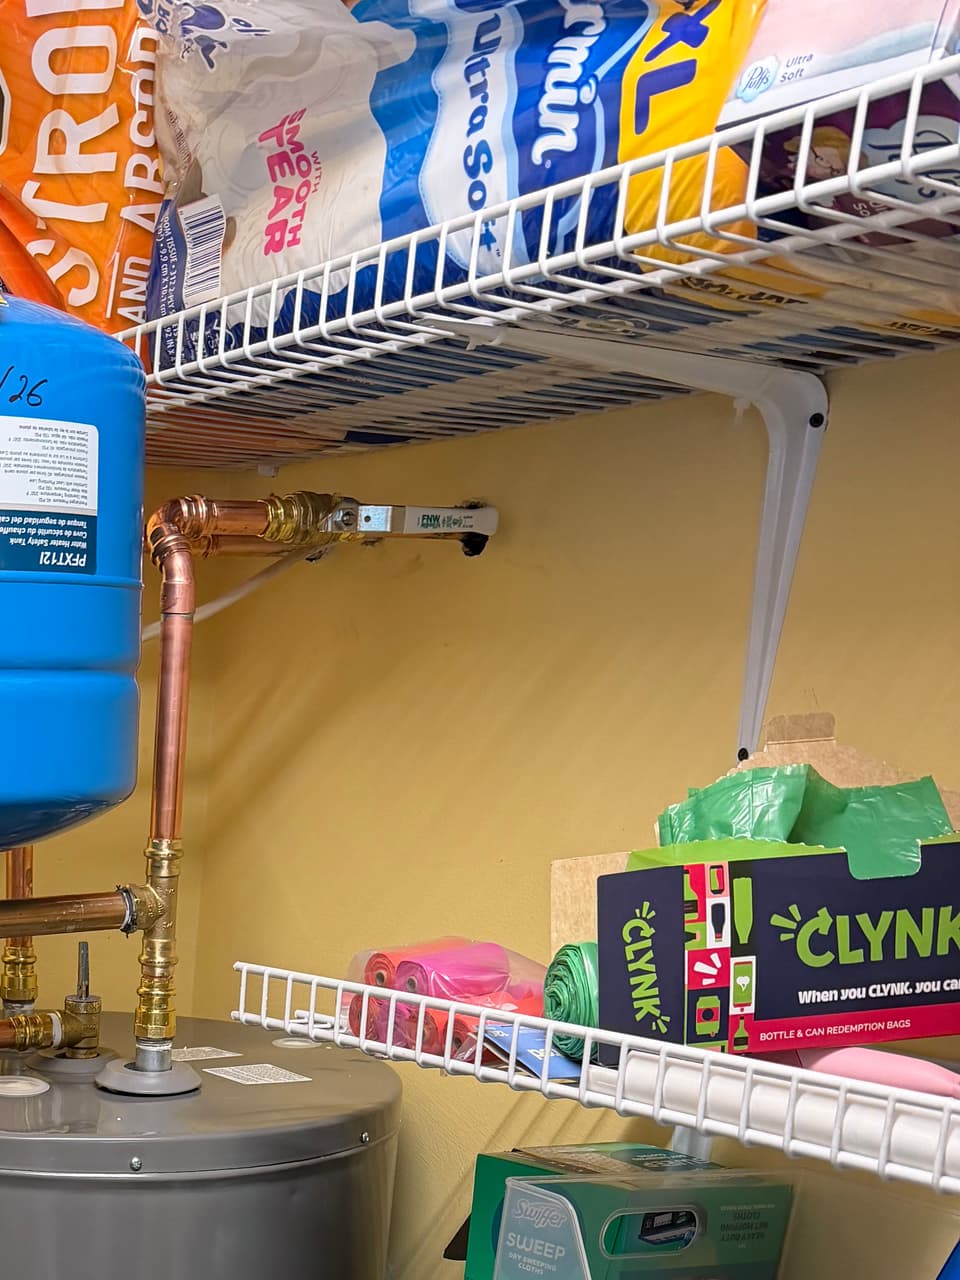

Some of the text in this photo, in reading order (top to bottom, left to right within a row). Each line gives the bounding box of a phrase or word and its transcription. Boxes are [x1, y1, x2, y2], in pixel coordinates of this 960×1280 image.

[785, 53, 814, 68] Ultra
[742, 66, 771, 92] Puffs
[779, 68, 804, 83] Soft
[463, 14, 501, 251] Ultra Sot
[21, 0, 124, 308] STRO
[284, 107, 312, 248] SMOOTH
[309, 150, 323, 194] WITH
[258, 115, 294, 257] TEAR
[166, 237, 178, 264] TISSUE
[117, 256, 148, 324] AND
[11, 516, 23, 524] del
[23, 517, 57, 526] seguridad
[27, 528, 37, 536] du
[58, 519, 66, 527] de
[67, 519, 87, 528] Tanque
[9, 537, 87, 549] Water Heater Safety Tank
[38, 529, 63, 537] sécurité
[63, 530, 73, 538] de
[795, 904, 960, 968] CLYNK
[621, 917, 661, 1021] CLYNK
[798, 989, 839, 1004] When
[840, 986, 866, 1000] you
[915, 980, 941, 993] you
[759, 1019, 911, 1041] BOTTLE & CAN REDEMPTION BAGS
[512, 1198, 567, 1228] Swiffer
[506, 1232, 566, 1260] SWEEP
